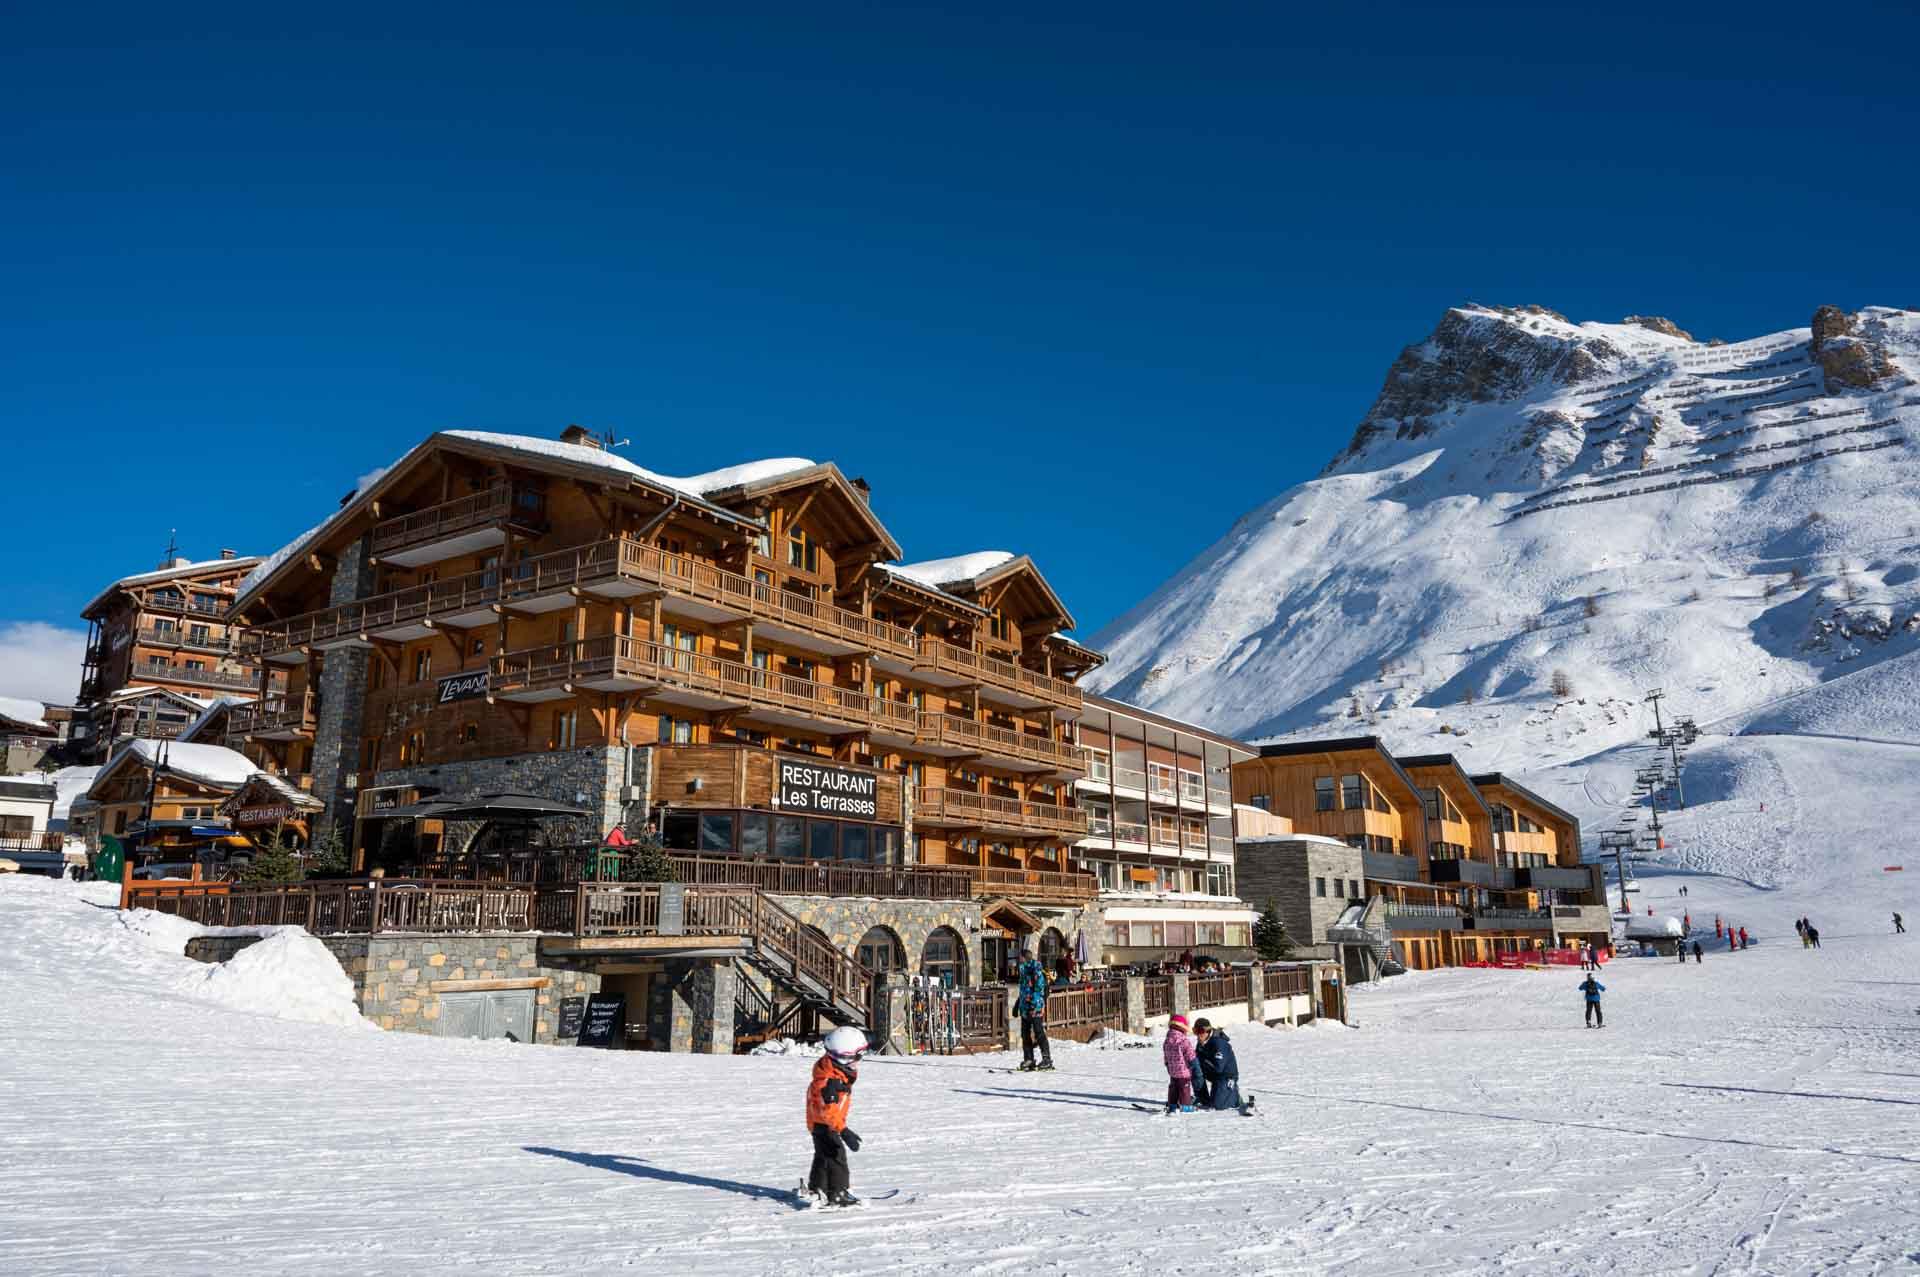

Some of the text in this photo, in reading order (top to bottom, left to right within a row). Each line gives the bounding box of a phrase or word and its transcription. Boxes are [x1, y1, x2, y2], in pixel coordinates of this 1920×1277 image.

[783, 765, 875, 795] RESTAURANT
[782, 785, 875, 815] Les Terrasses
